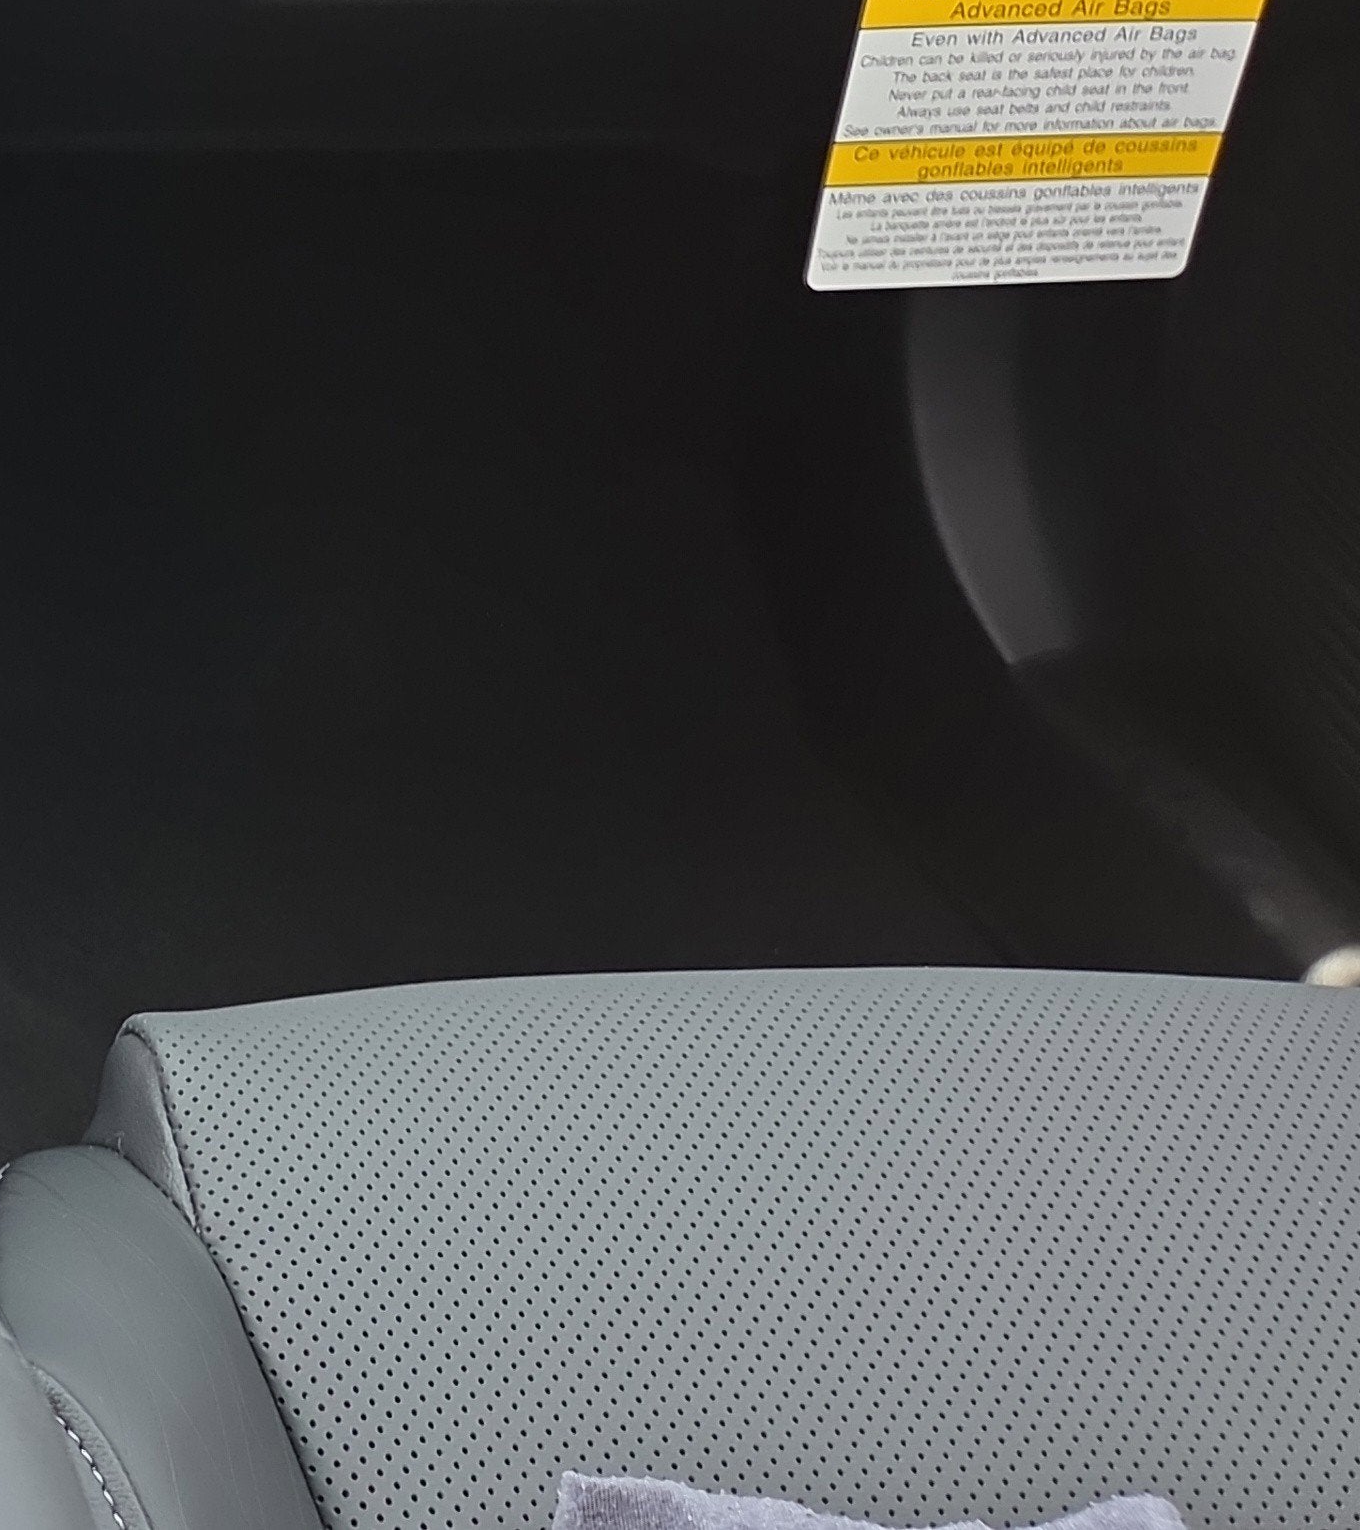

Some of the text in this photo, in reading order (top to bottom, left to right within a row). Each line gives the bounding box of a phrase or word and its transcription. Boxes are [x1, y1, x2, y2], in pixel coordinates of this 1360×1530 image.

[911, 25, 1198, 48] Even with Advanced Air Bags
[860, 53, 914, 69] Children
[918, 54, 943, 67] can
[947, 53, 964, 66] be
[1161, 47, 1183, 60] the
[894, 71, 917, 84] The
[853, 137, 1199, 162] Ce véhicule est équipé de coussins
[917, 156, 1125, 179] gonflables intelligents
[882, 191, 919, 204] avec
[925, 188, 954, 203] des
[960, 186, 1026, 202] coussins
[1034, 183, 1112, 201] gonflables
[1118, 181, 1199, 198] intelligents
